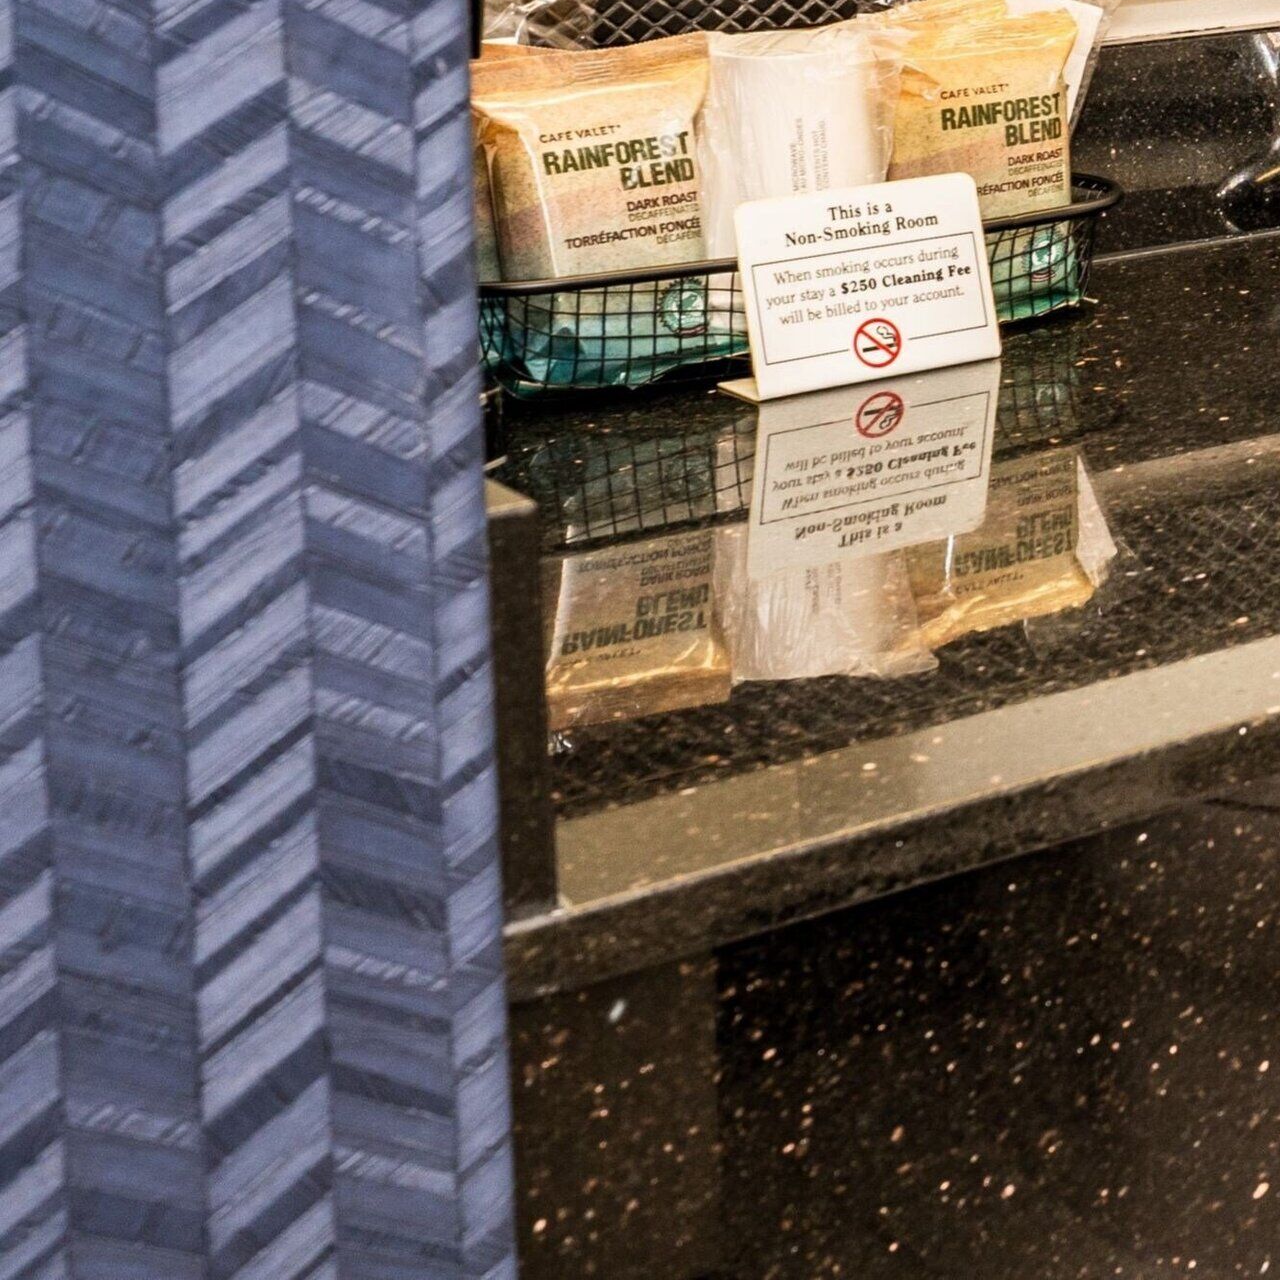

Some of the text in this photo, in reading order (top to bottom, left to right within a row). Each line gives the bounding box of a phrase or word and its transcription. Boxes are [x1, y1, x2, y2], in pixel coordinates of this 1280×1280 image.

[941, 92, 1060, 131] RAINFOREST
[1005, 117, 1062, 147] BLEND
[542, 131, 689, 176] RAINFOREST
[1008, 148, 1063, 167] DARK ROAST
[619, 157, 695, 191] BLEND
[977, 171, 1064, 197] RÉFACTION FONCÉE
[626, 191, 698, 212] DARK ROAST
[828, 202, 893, 221] This is a
[564, 215, 702, 250] TORRÉFACTION FONCÉE
[785, 215, 938, 247] Non-Smoking Room
[773, 246, 959, 285] When smoking occurs during
[766, 264, 971, 310] your stay a $250 Cleaning Fee
[779, 285, 965, 326] will be billed to your account.
